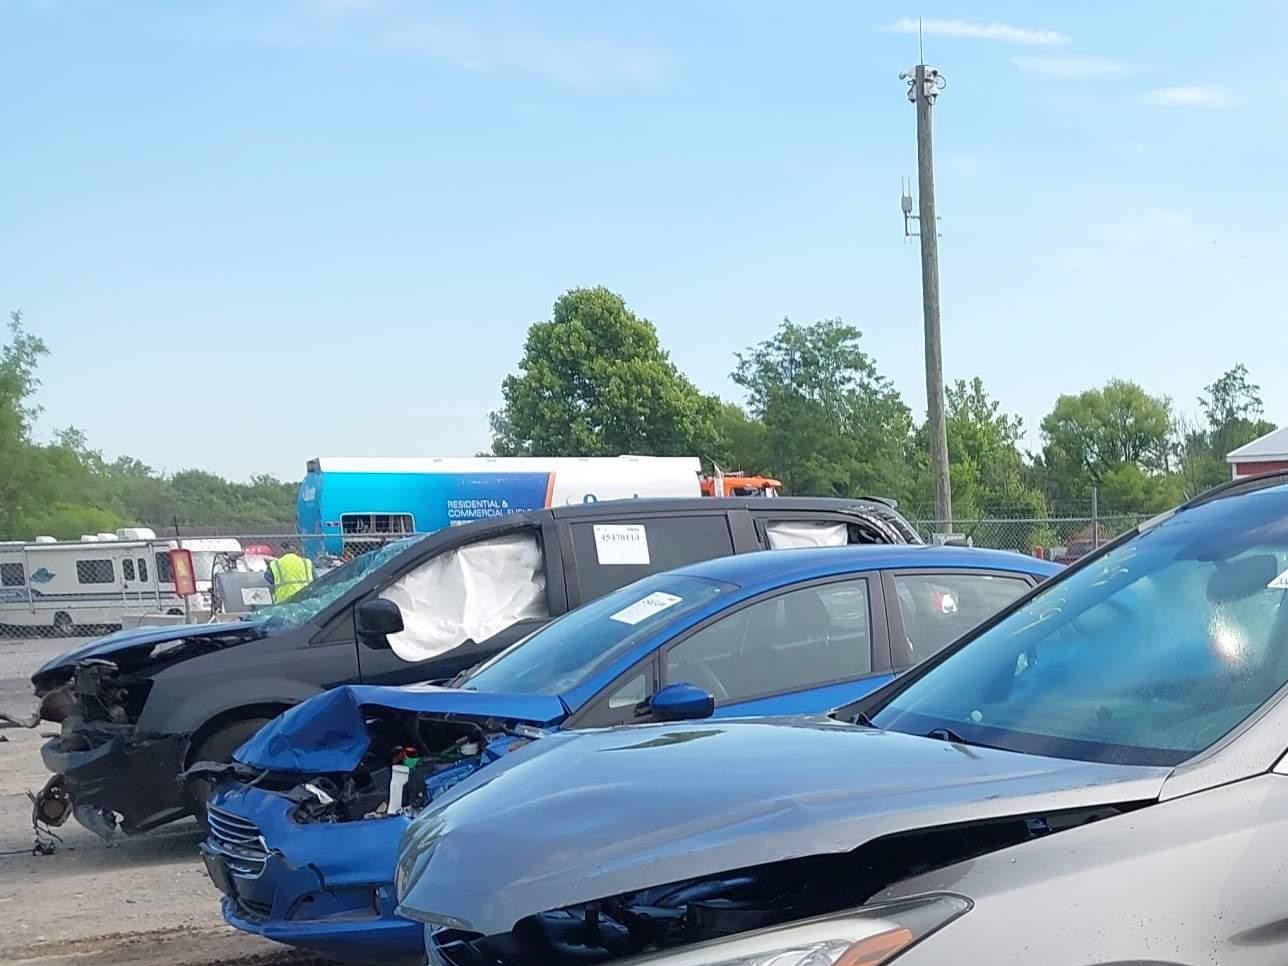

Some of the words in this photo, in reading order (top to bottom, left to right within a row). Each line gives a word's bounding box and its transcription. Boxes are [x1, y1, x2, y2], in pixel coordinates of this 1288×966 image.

[447, 500, 500, 509] RESIDENTIAL
[501, 500, 509, 508] &
[448, 509, 504, 518] COMMERCIAL
